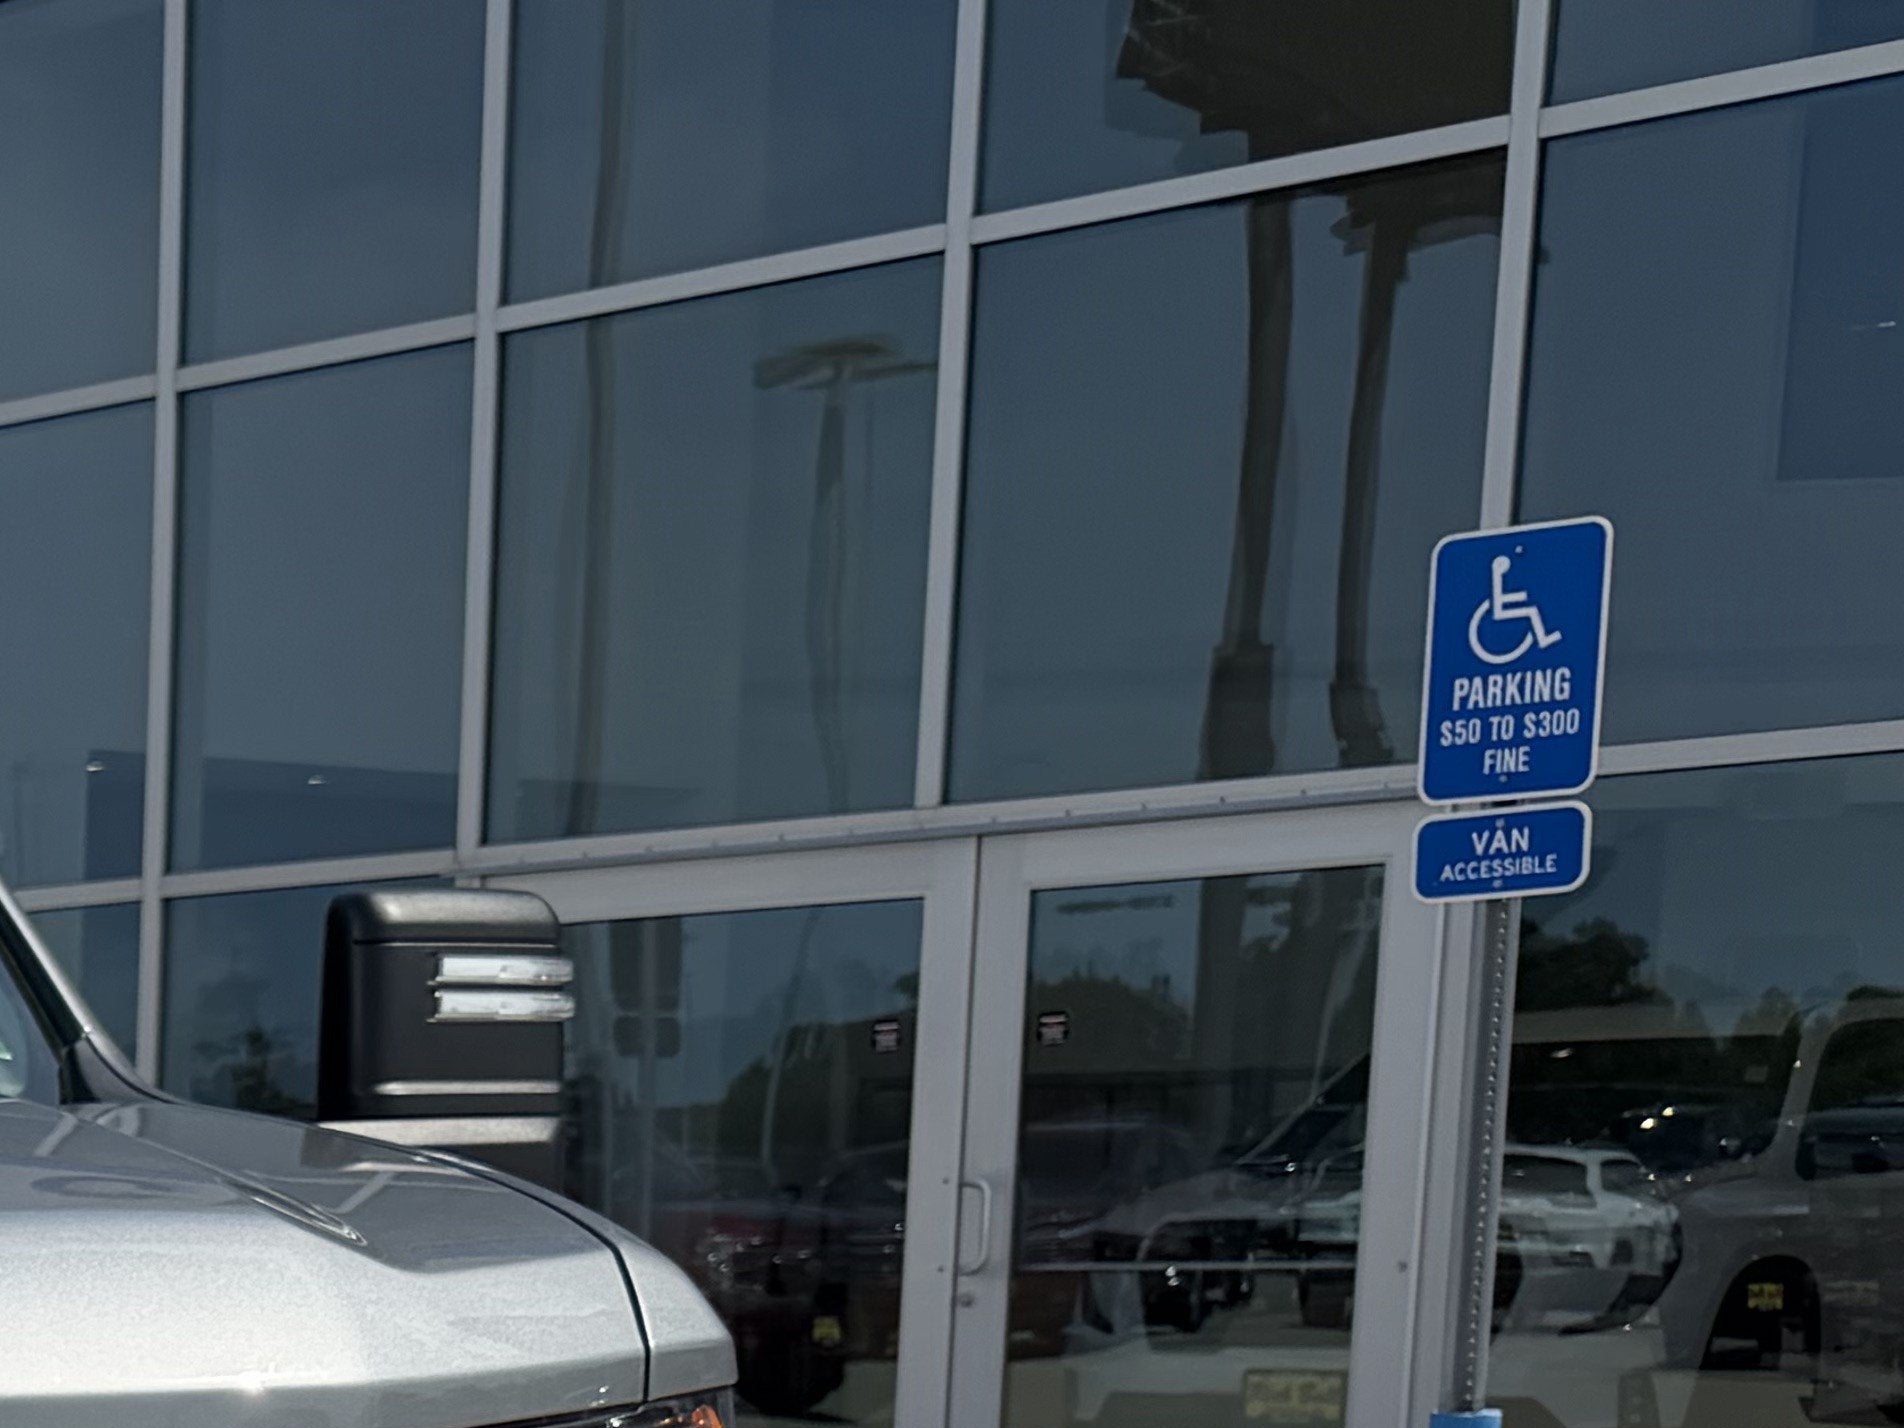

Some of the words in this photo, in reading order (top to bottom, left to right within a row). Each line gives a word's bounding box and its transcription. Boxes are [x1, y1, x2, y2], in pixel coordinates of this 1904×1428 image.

[1452, 666, 1572, 711] PARKING
[1439, 718, 1481, 747] $50
[1489, 714, 1514, 742] TO
[1523, 707, 1581, 739] $300
[1482, 746, 1532, 775] FINE
[1470, 826, 1530, 856] VAN
[1439, 853, 1558, 883] ACCESSIBLE
